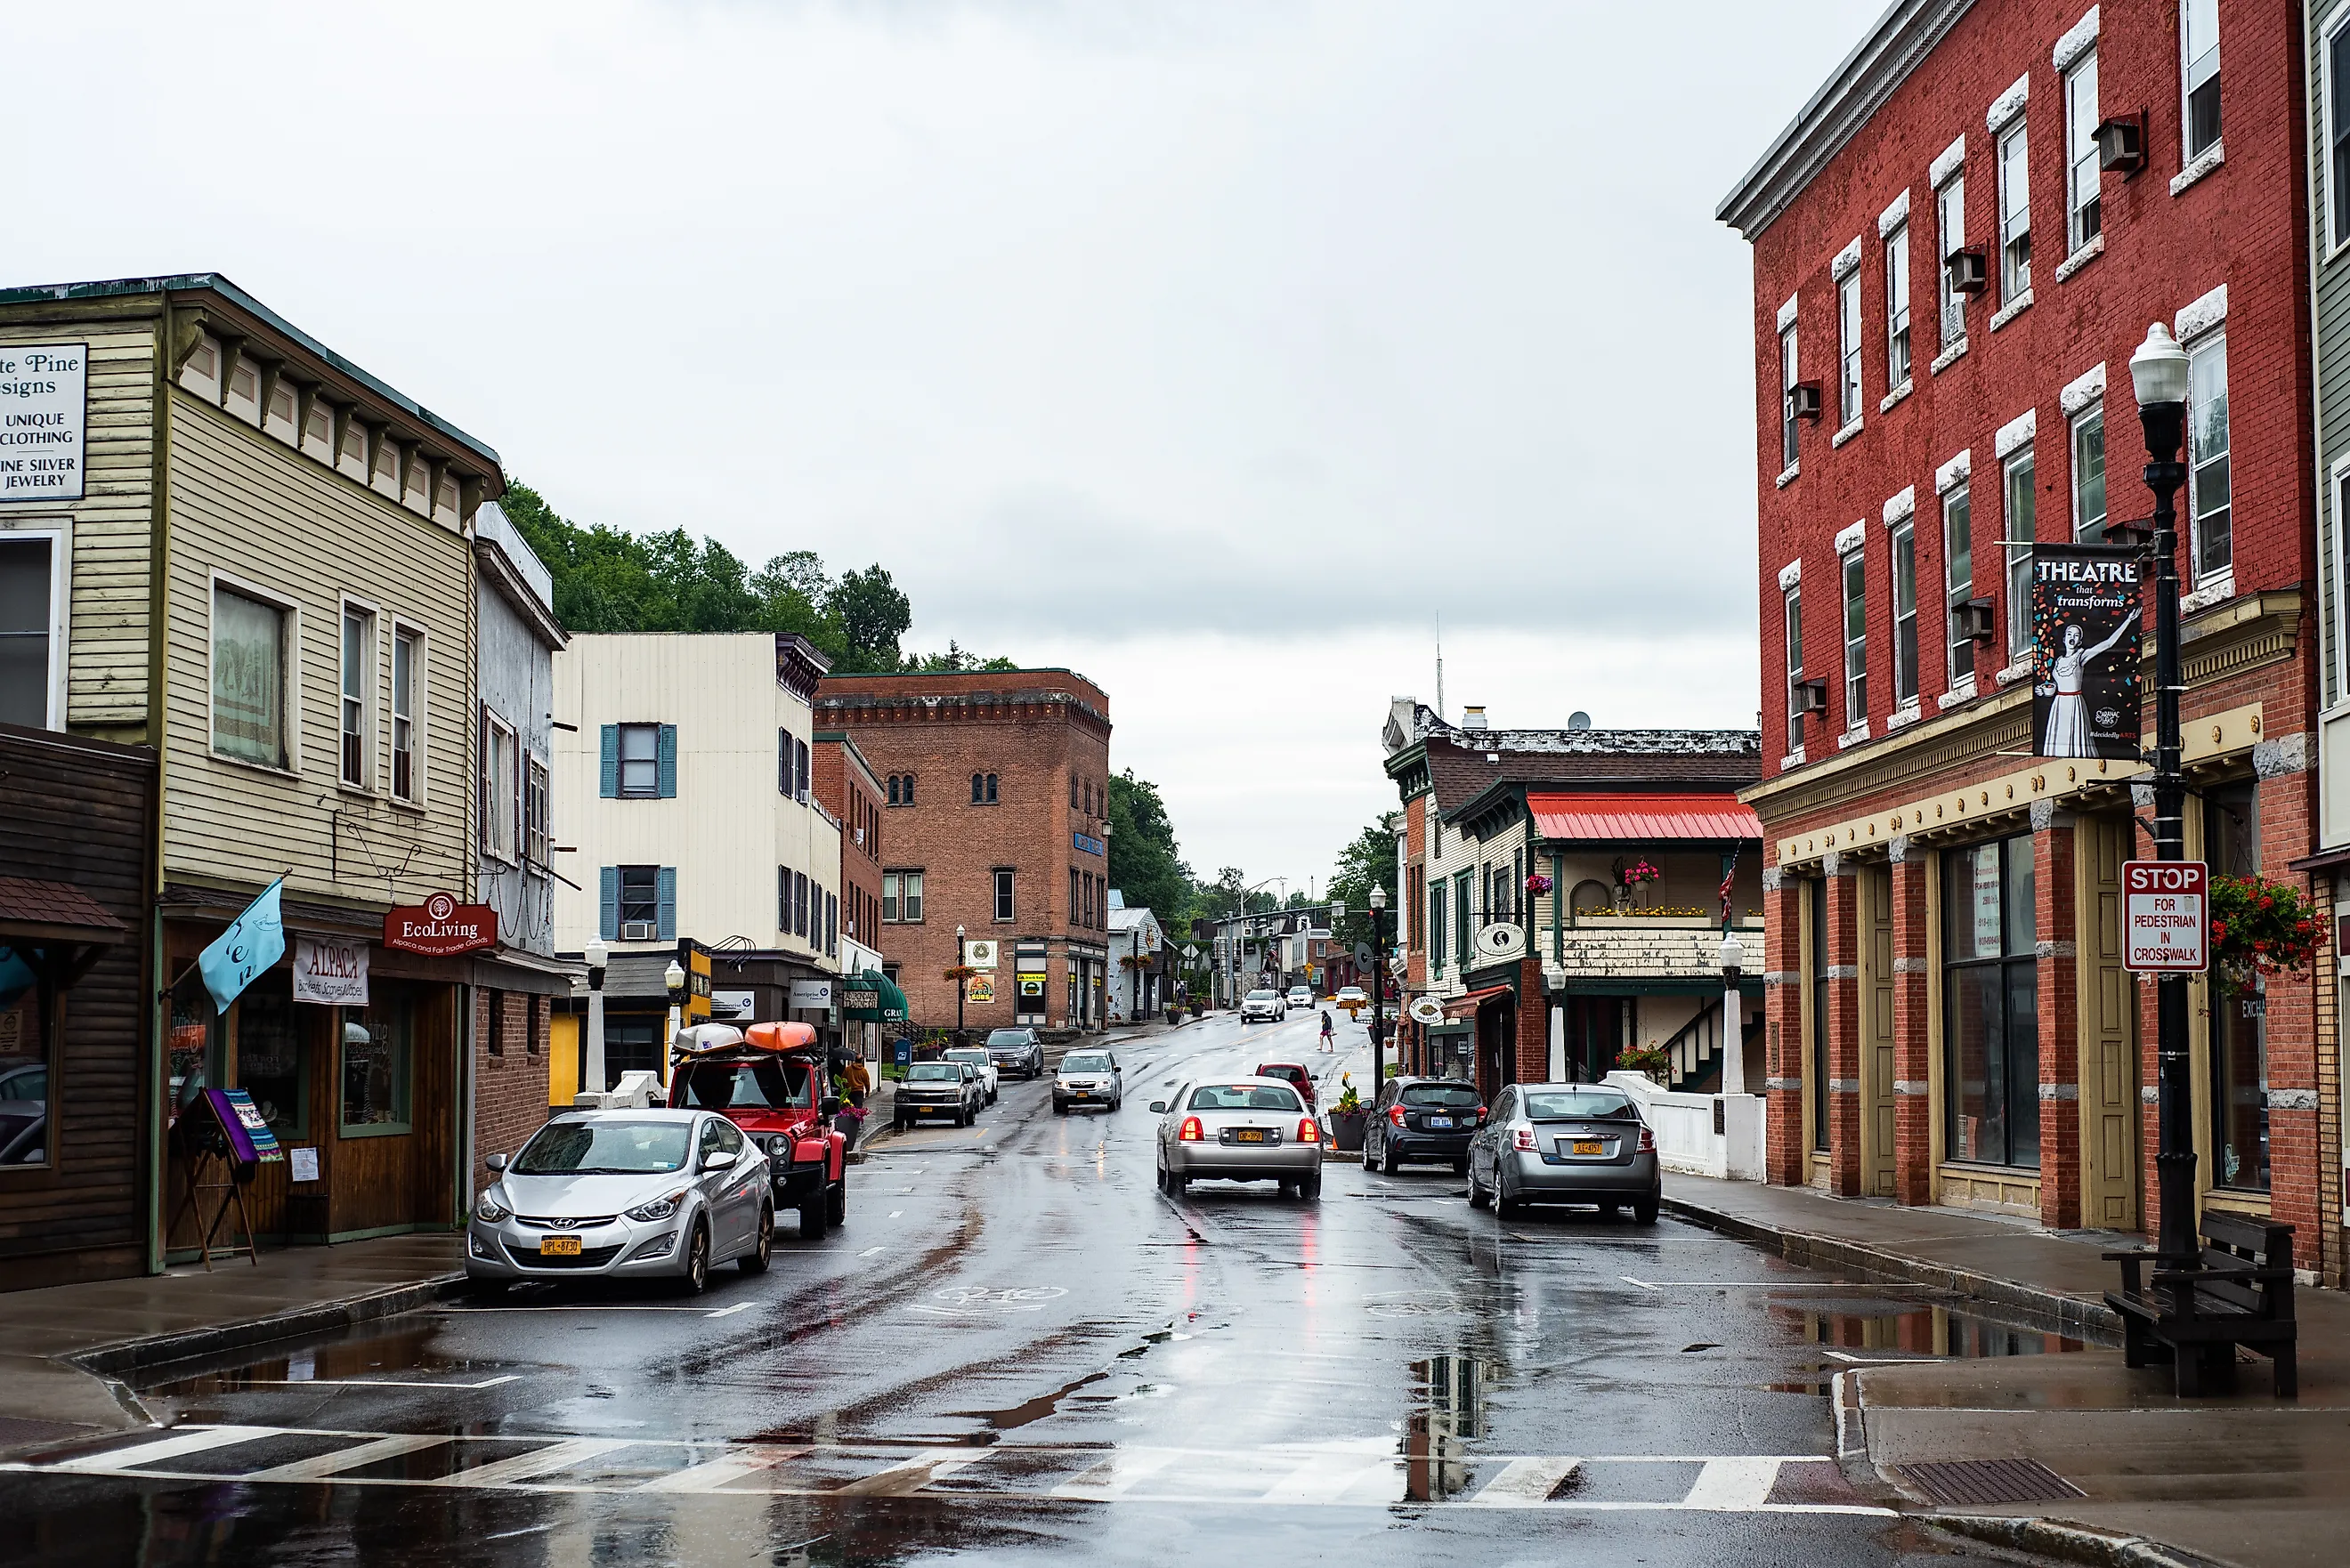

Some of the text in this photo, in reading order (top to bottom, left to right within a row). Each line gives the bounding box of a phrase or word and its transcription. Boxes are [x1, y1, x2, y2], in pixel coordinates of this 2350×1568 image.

[25, 354, 78, 373] Pine
[0, 377, 56, 398] signs
[5, 413, 64, 428] UNIQUE
[0, 431, 73, 446] CLOTHING
[0, 458, 75, 473] INE SILVER
[5, 474, 66, 489] JEWELRY
[2038, 561, 2138, 583] THEATRE
[2076, 585, 2093, 594] that
[2057, 595, 2125, 609] transforms
[2130, 869, 2200, 889] STOP
[2154, 898, 2176, 911] FOR
[2135, 915, 2196, 928] PEDESTRIAN
[402, 920, 479, 939] EcoLiving
[393, 936, 488, 954] Alpaca and Fair Trade Goods
[2160, 931, 2170, 944] IN
[307, 944, 358, 979] ALPACA
[2134, 948, 2197, 961] CROSSWALK
